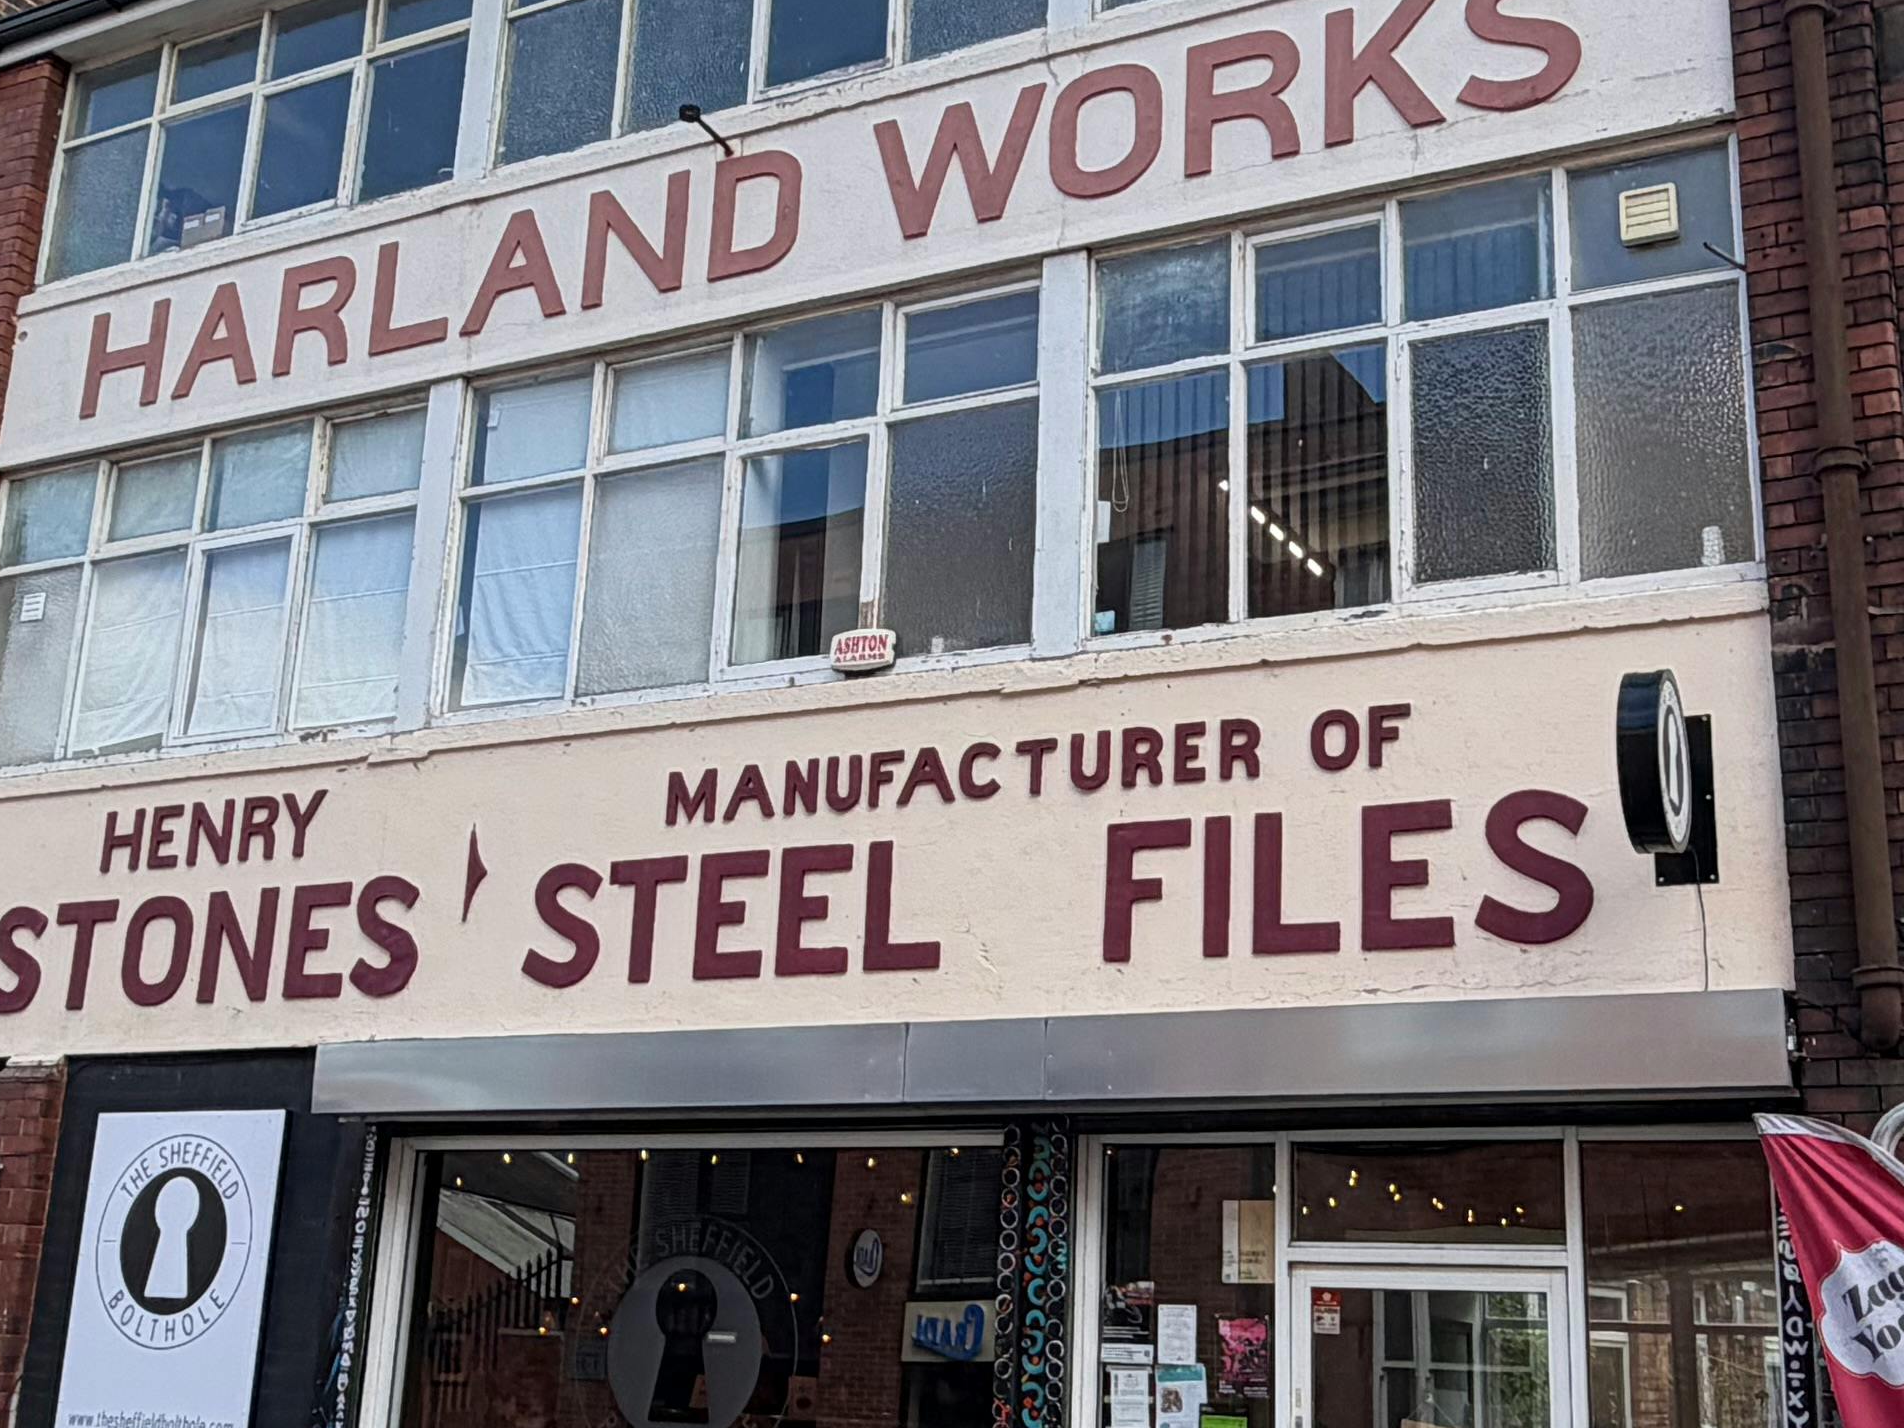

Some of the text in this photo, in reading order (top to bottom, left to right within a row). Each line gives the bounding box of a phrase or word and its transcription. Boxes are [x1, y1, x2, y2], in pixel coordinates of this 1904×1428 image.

[79, 149, 802, 420] HARLAND
[835, 634, 888, 654] ASHTON
[666, 703, 1411, 826] MANUFACTURER OF
[100, 789, 329, 873] HENRY
[521, 789, 1594, 988] STEEL FILES
[120, 1141, 240, 1200] THE SHEFFIELD
[655, 1223, 775, 1300] SHEFFIELD
[108, 1288, 225, 1342] BOLTHOLE
